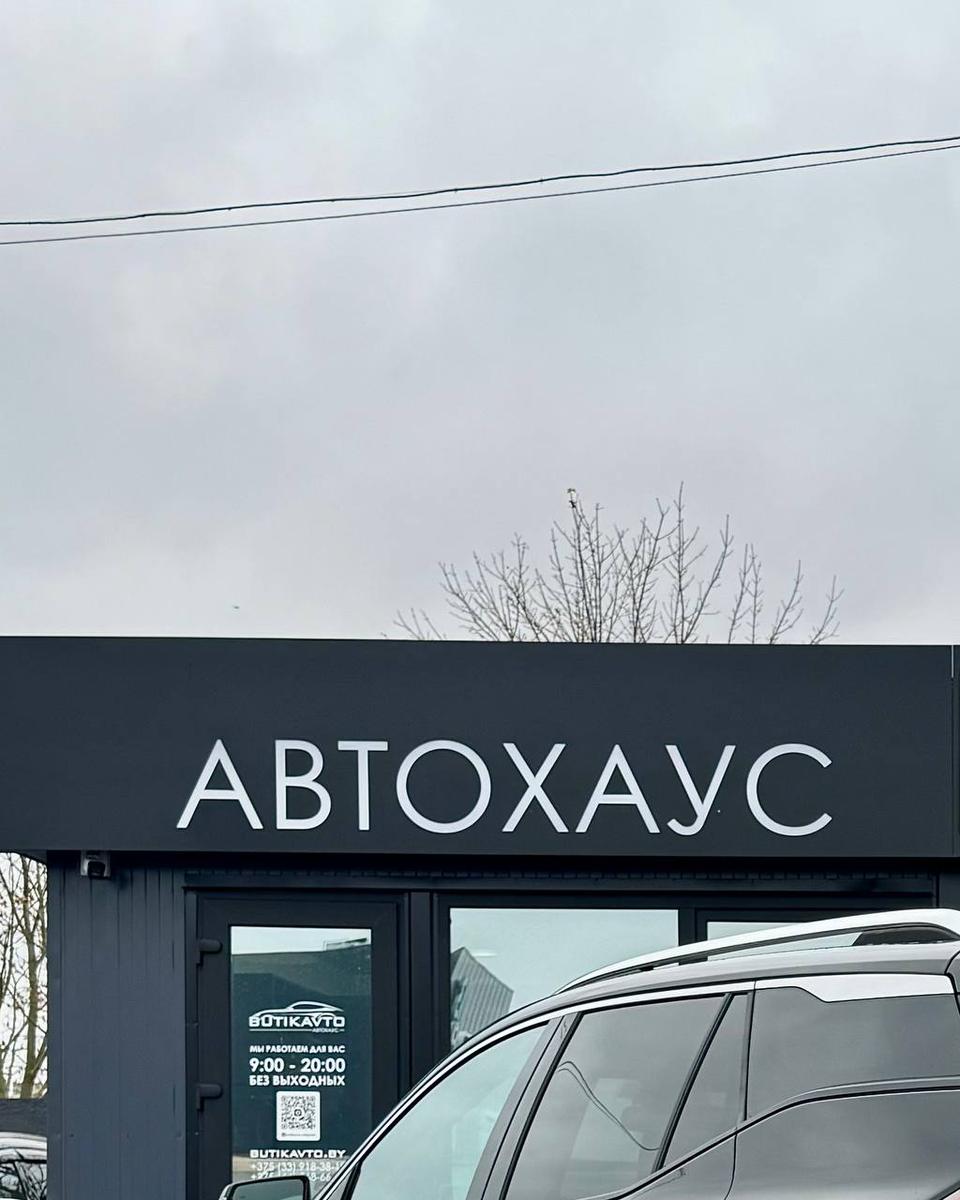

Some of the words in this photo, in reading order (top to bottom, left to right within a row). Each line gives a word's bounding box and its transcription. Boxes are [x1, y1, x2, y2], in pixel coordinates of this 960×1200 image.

[176, 739, 833, 837] АВТОХАУС
[248, 1015, 346, 1028] BUTIKAVTO
[249, 1045, 265, 1053] МЫ
[266, 1045, 309, 1053] РАБОТАЕМ
[309, 1045, 327, 1054] ДЛЯ
[328, 1045, 346, 1053] ВАС
[249, 1057, 285, 1073] 9:00
[300, 1057, 346, 1073] 20:00
[249, 1074, 270, 1087] БЕЗ
[272, 1075, 346, 1088] ВЫХОДНЫХ
[249, 1149, 347, 1159] BUTIKAVTO.BY
